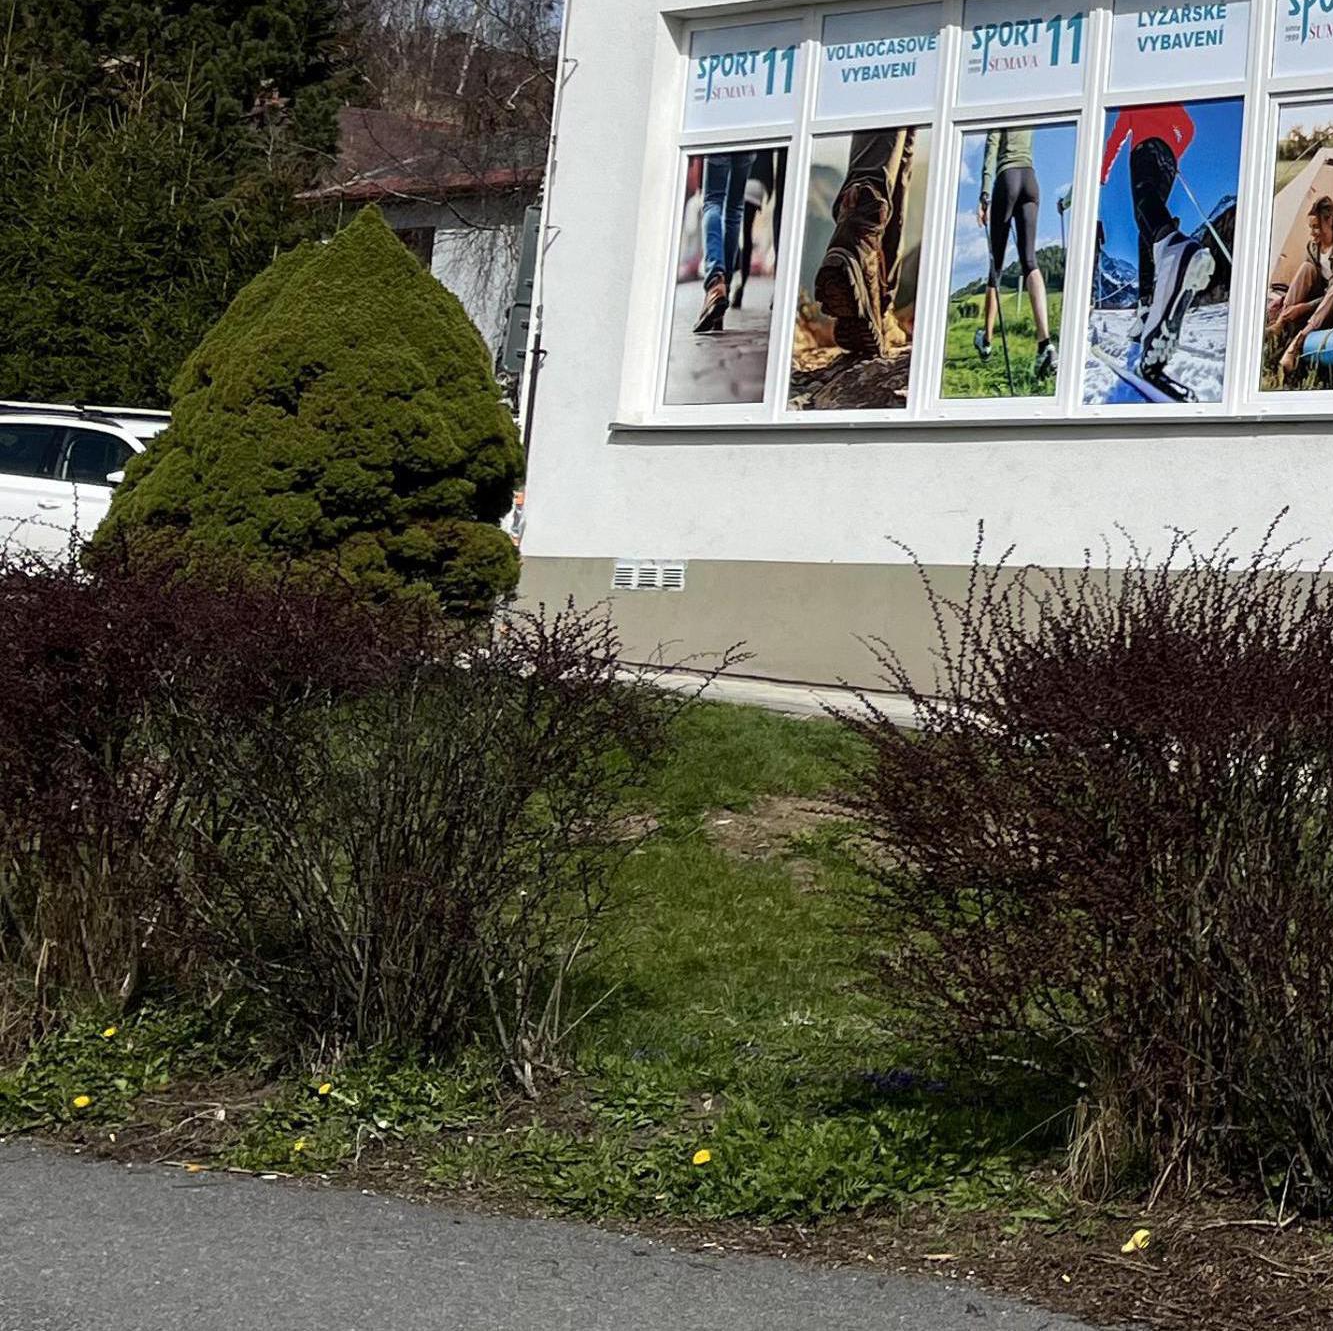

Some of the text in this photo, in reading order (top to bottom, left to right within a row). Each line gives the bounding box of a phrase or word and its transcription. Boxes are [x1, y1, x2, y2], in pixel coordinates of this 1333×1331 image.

[1138, 0, 1227, 28] LYŽAŘSKÉ
[827, 31, 937, 62] VOLNOČASOVÉ
[972, 11, 1084, 75] SPORT 11
[1138, 25, 1224, 53] VYBAVENÍ
[697, 45, 797, 102] SPORT 11
[842, 59, 916, 83] VYBAVENÍ
